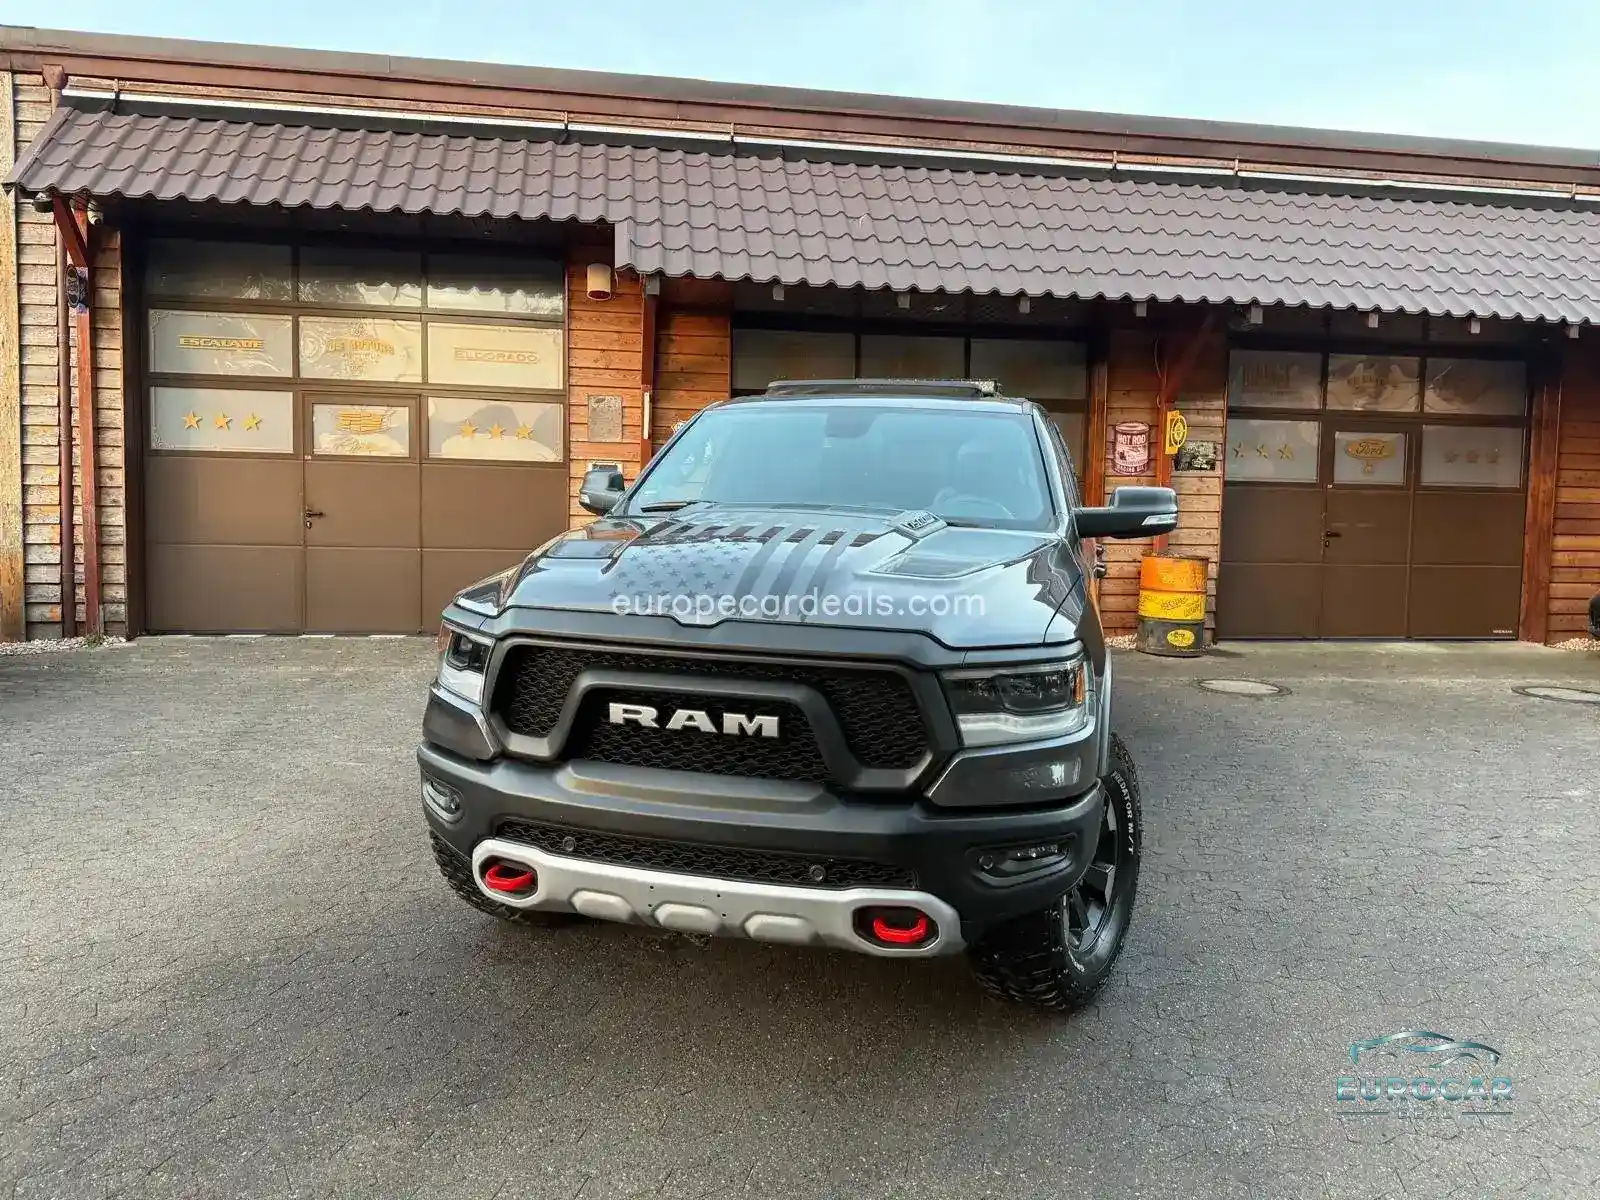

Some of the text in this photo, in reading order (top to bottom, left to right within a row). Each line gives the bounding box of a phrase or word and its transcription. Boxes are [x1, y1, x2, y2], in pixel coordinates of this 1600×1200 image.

[179, 337, 264, 349] ESCALADE
[454, 348, 538, 363] ELDORADO
[1117, 433, 1146, 445] HOT ROD
[608, 702, 779, 737] RAM
